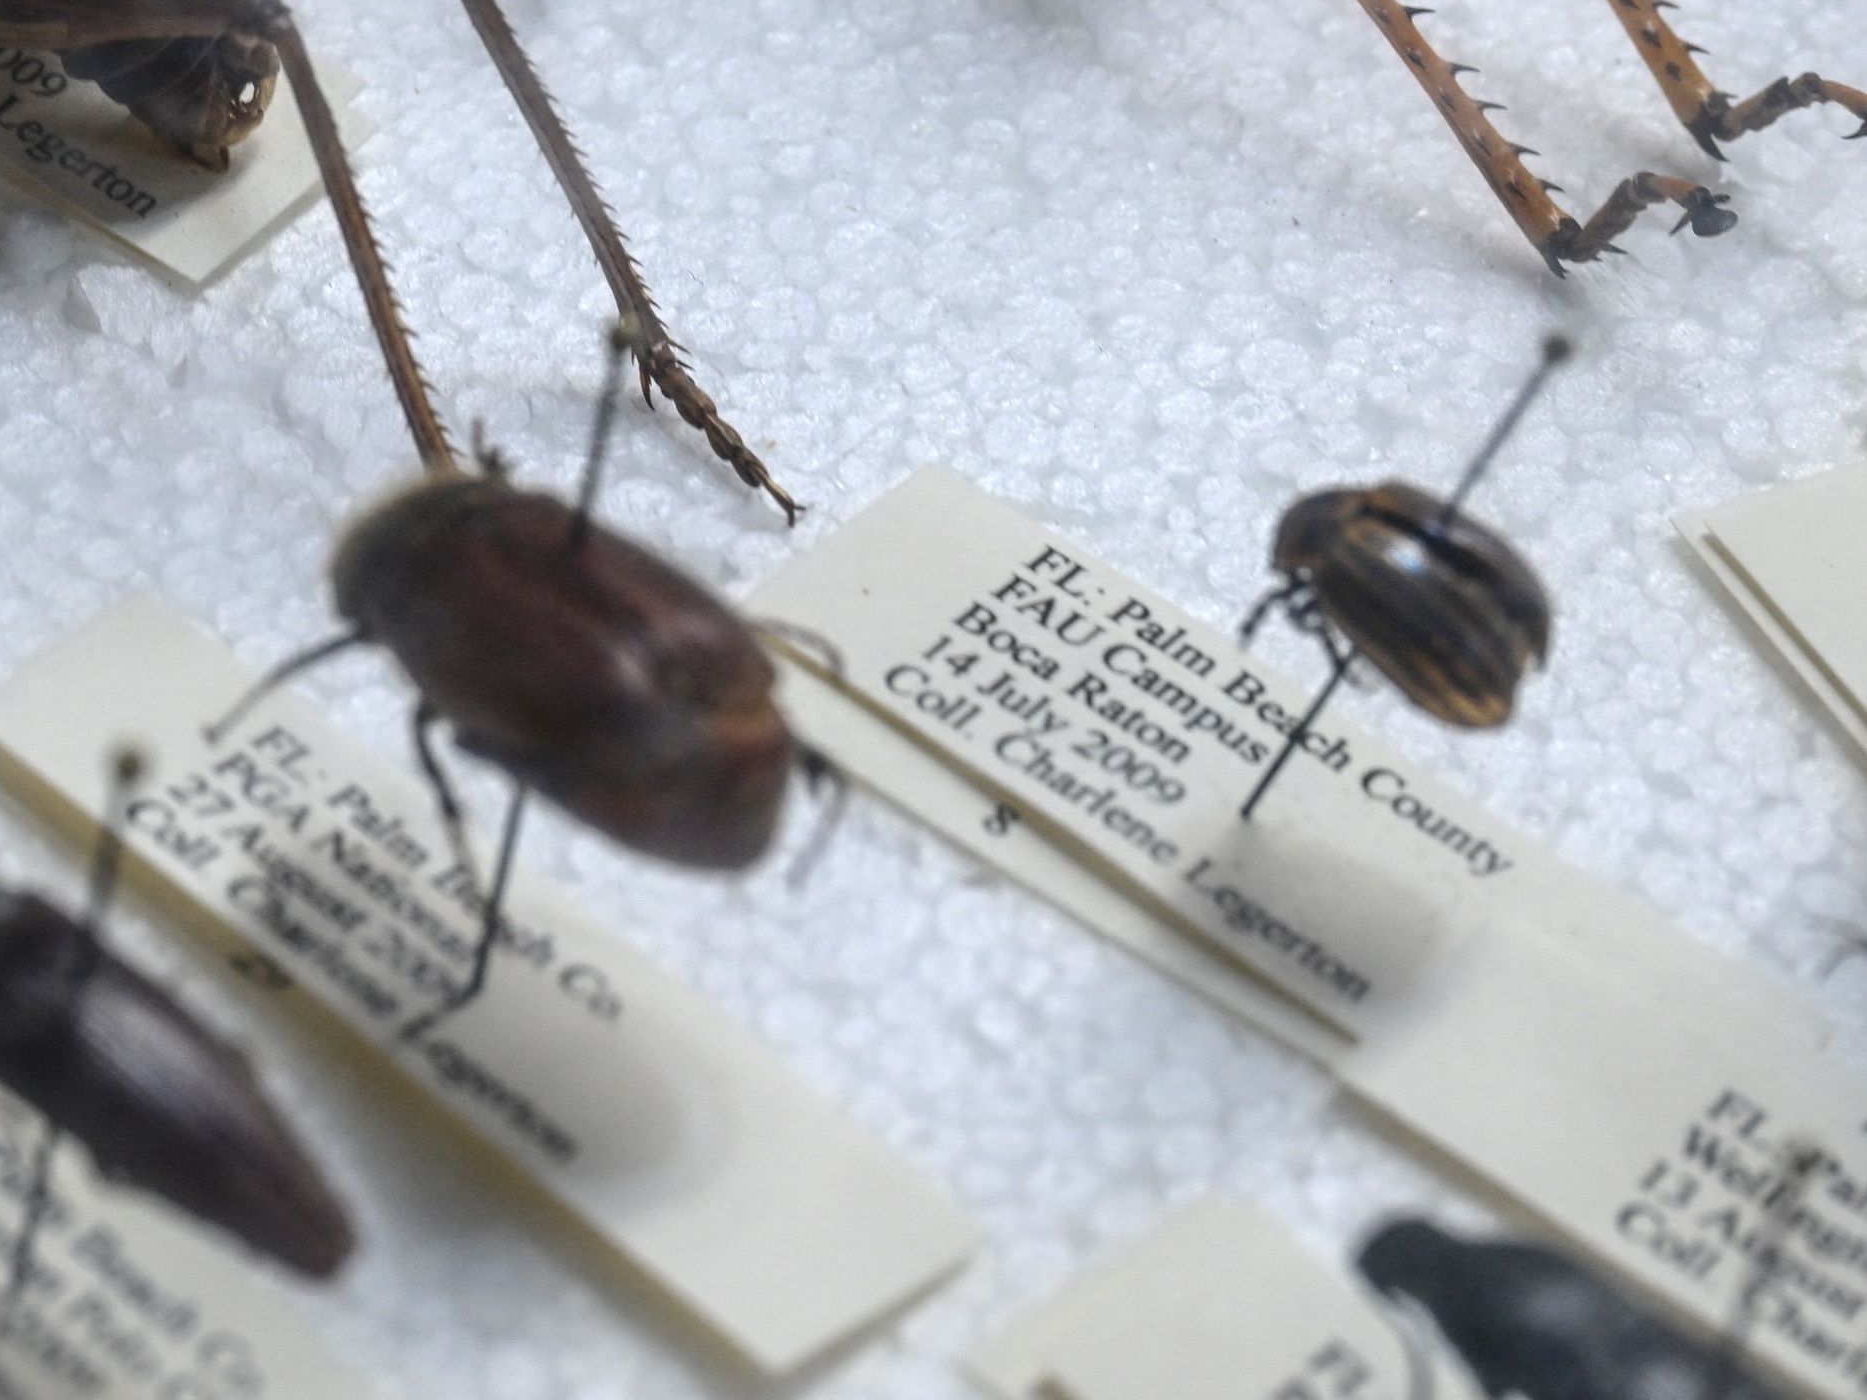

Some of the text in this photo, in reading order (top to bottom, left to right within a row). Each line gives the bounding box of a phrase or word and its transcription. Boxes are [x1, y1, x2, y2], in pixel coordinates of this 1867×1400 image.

[921, 634, 1187, 808] 14 July 2009
[952, 600, 1194, 766] Boca Raton
[990, 572, 1272, 767] FAU Campus
[1023, 544, 1516, 879] FL: Palm Beach County
[432, 861, 555, 969] Bech
[883, 662, 1372, 1005] Coll. Charlene Legerton
